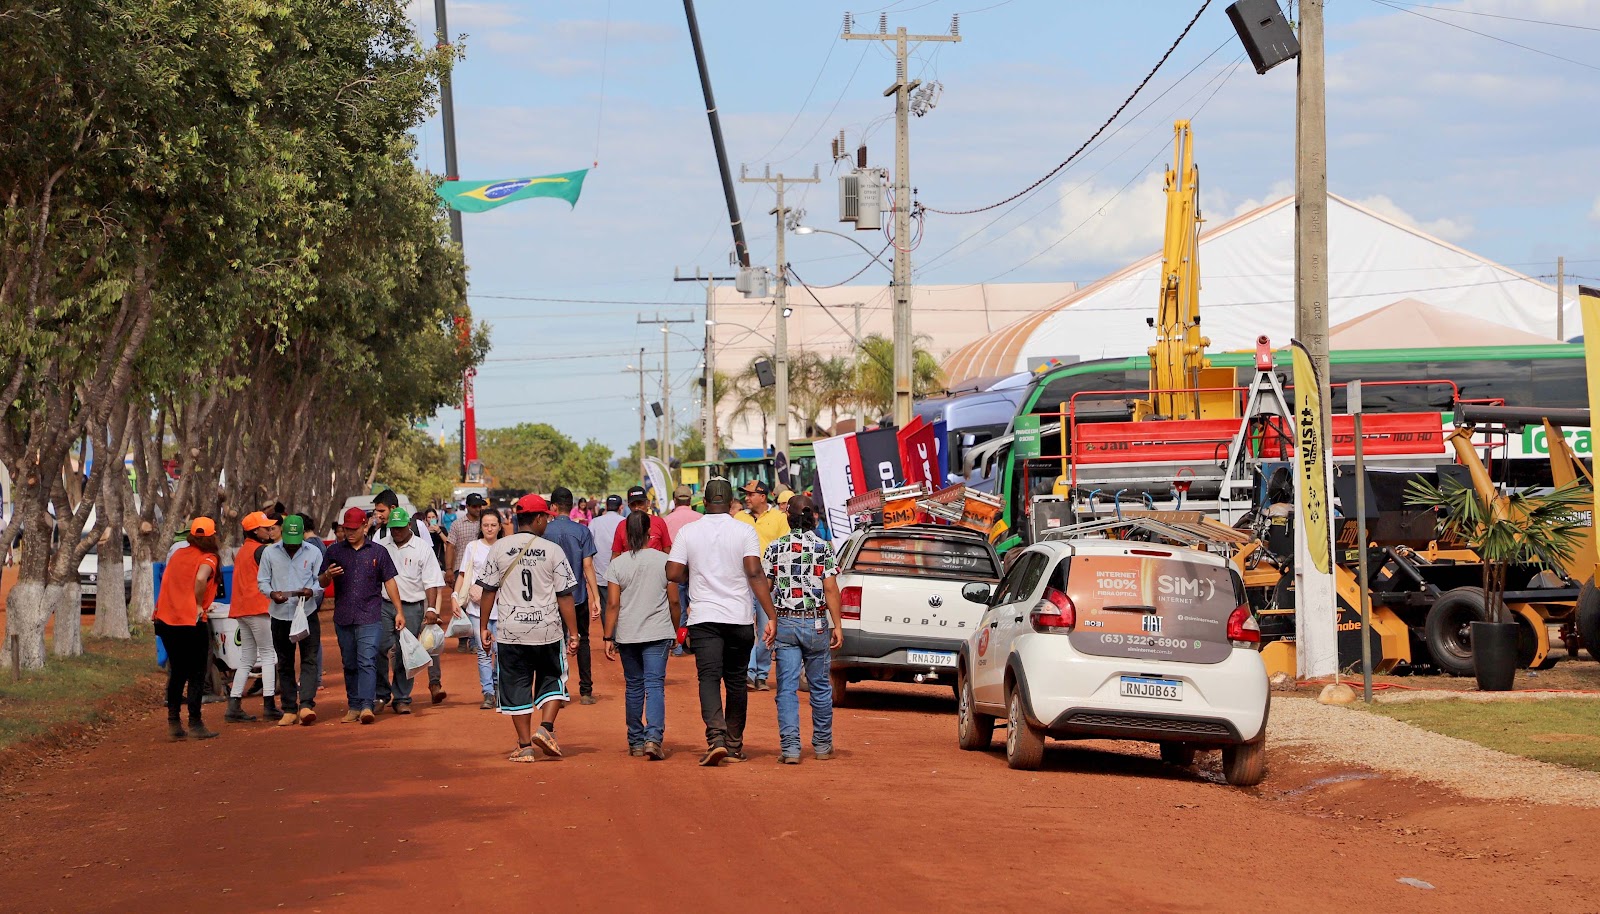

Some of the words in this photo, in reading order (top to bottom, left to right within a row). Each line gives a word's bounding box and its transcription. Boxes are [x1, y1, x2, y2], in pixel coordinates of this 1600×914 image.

[521, 568, 533, 601] 9
[1096, 578, 1137, 590] 100%
[1158, 596, 1192, 604] INTERNET
[1141, 615, 1163, 632] FIAT
[1100, 633, 1123, 645] (63)
[912, 653, 952, 665] RNA3D79
